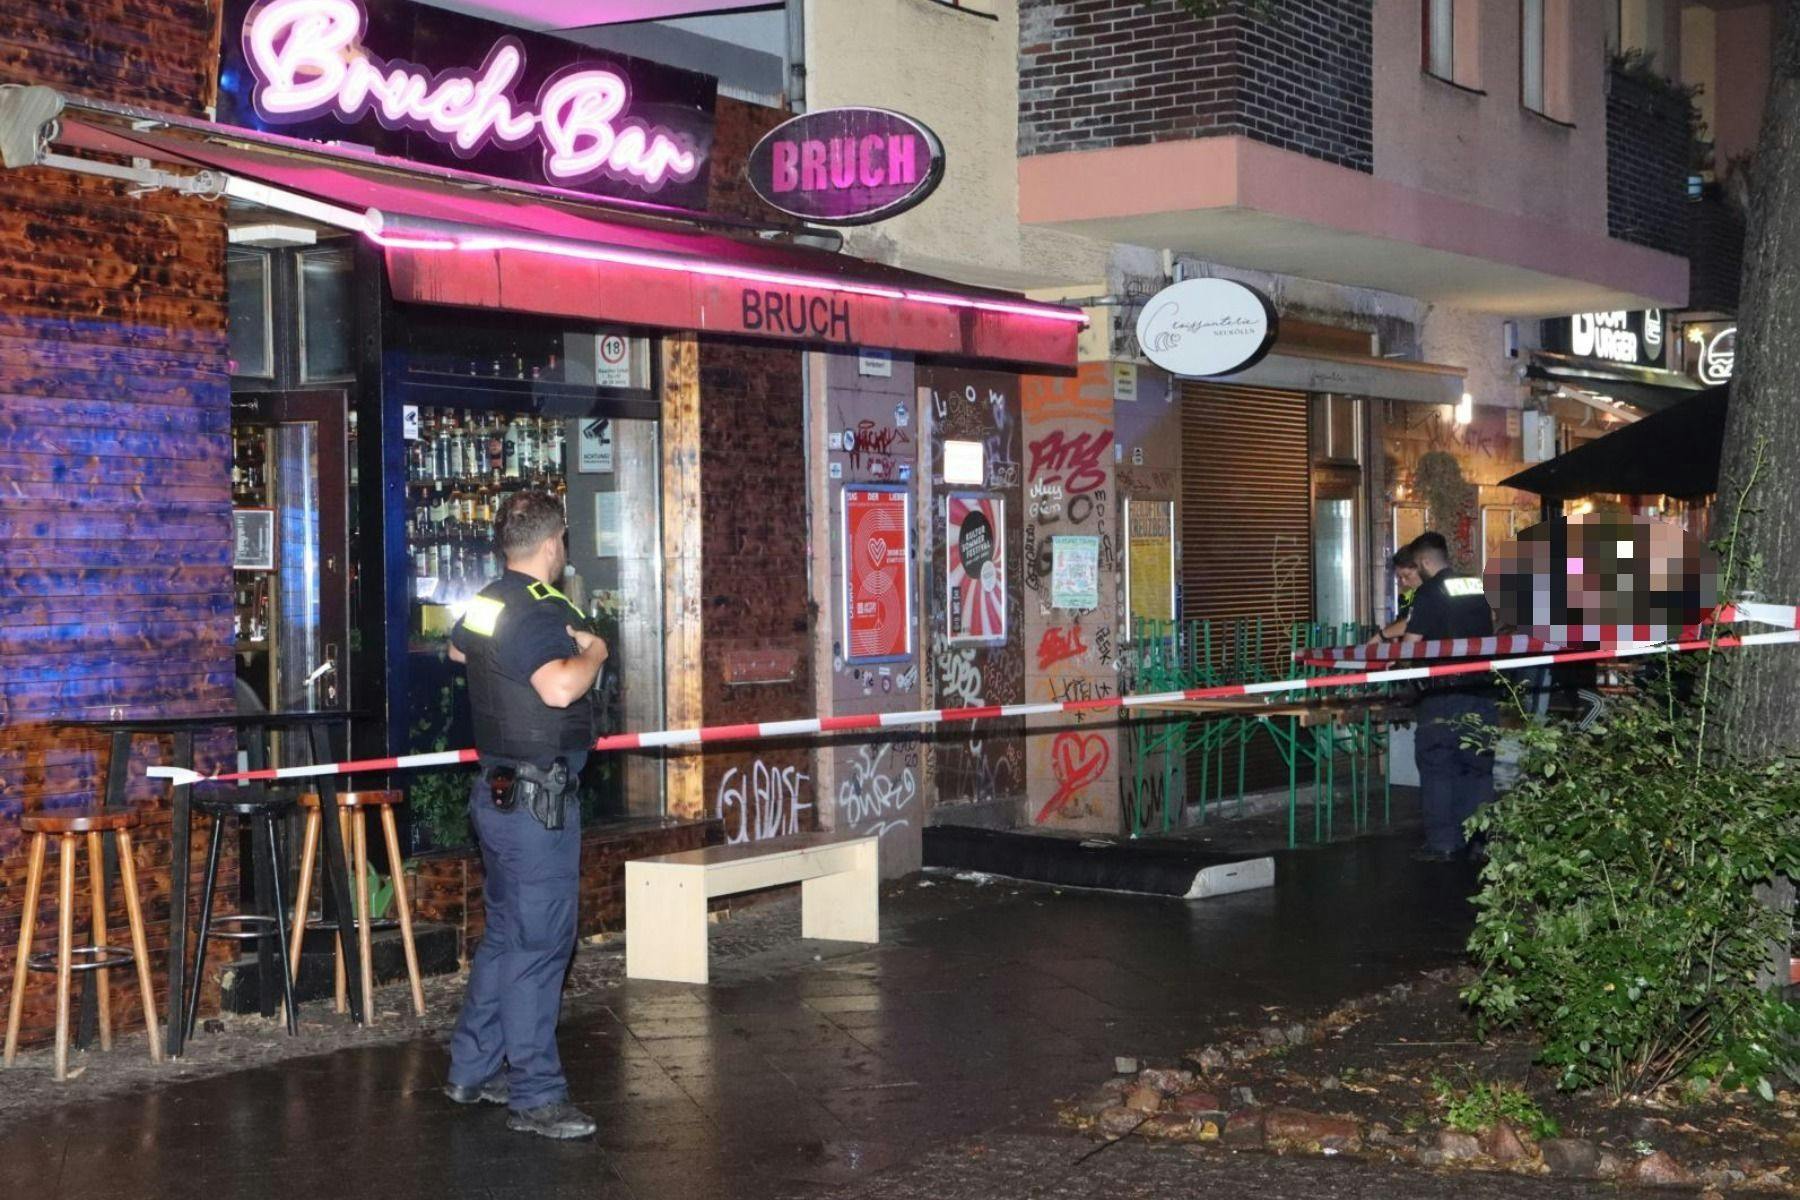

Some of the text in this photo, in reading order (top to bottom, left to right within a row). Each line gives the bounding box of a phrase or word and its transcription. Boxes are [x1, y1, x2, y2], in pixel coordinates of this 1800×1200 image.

[251, 0, 694, 184] Bruch Bar
[772, 134, 915, 193] BRUCH
[742, 288, 850, 343] BRUCH
[606, 341, 620, 355] 18
